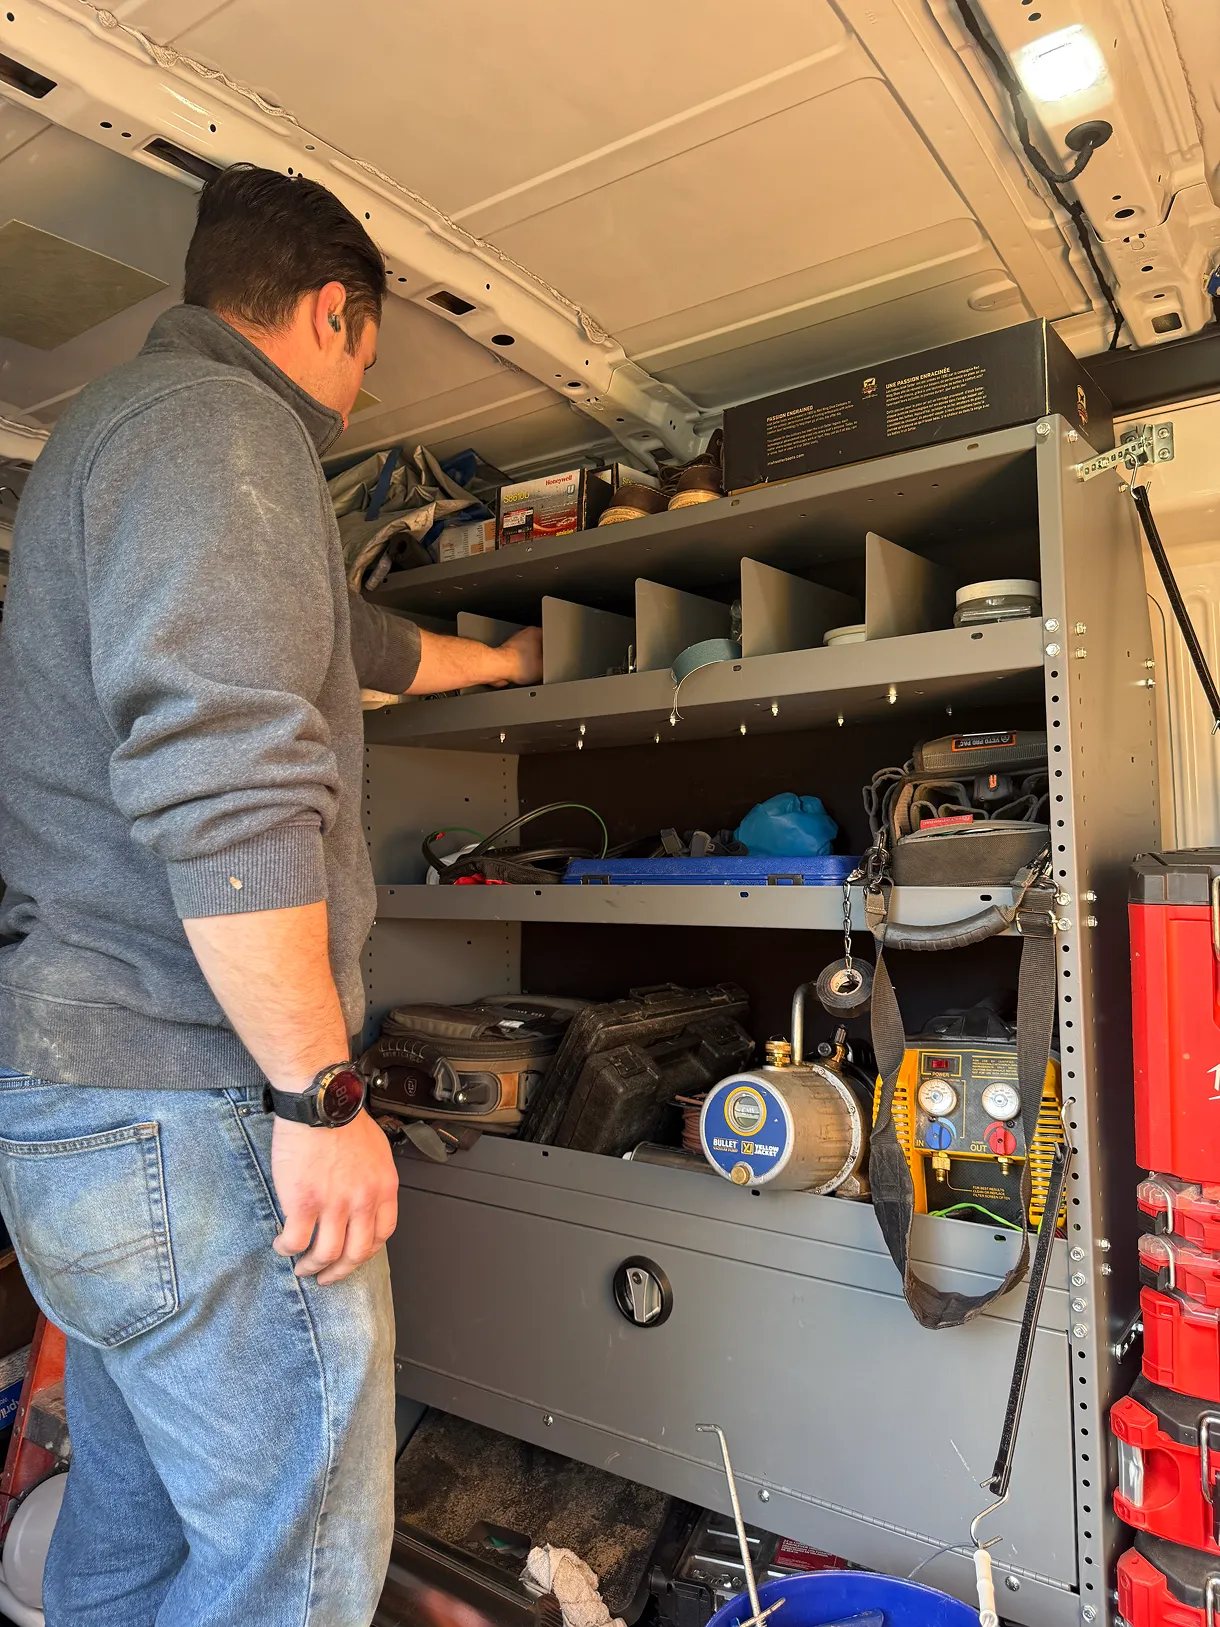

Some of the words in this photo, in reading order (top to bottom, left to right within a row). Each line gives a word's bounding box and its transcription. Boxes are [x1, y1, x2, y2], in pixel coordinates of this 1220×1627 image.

[885, 381, 897, 389] UNE
[897, 376, 919, 386] PASSION
[920, 367, 951, 380] ENRACINÉE
[766, 413, 786, 422] PASSION
[787, 405, 813, 416] ENGRAINED
[545, 474, 573, 486] Honeywell
[503, 491, 530, 504] S8610U
[713, 1138, 738, 1148] BULLET
[754, 1143, 779, 1152] YELLOW
[970, 1144, 988, 1152] OUT
[754, 1149, 778, 1157] JACKET
[0, 1398, 19, 1421] pril
